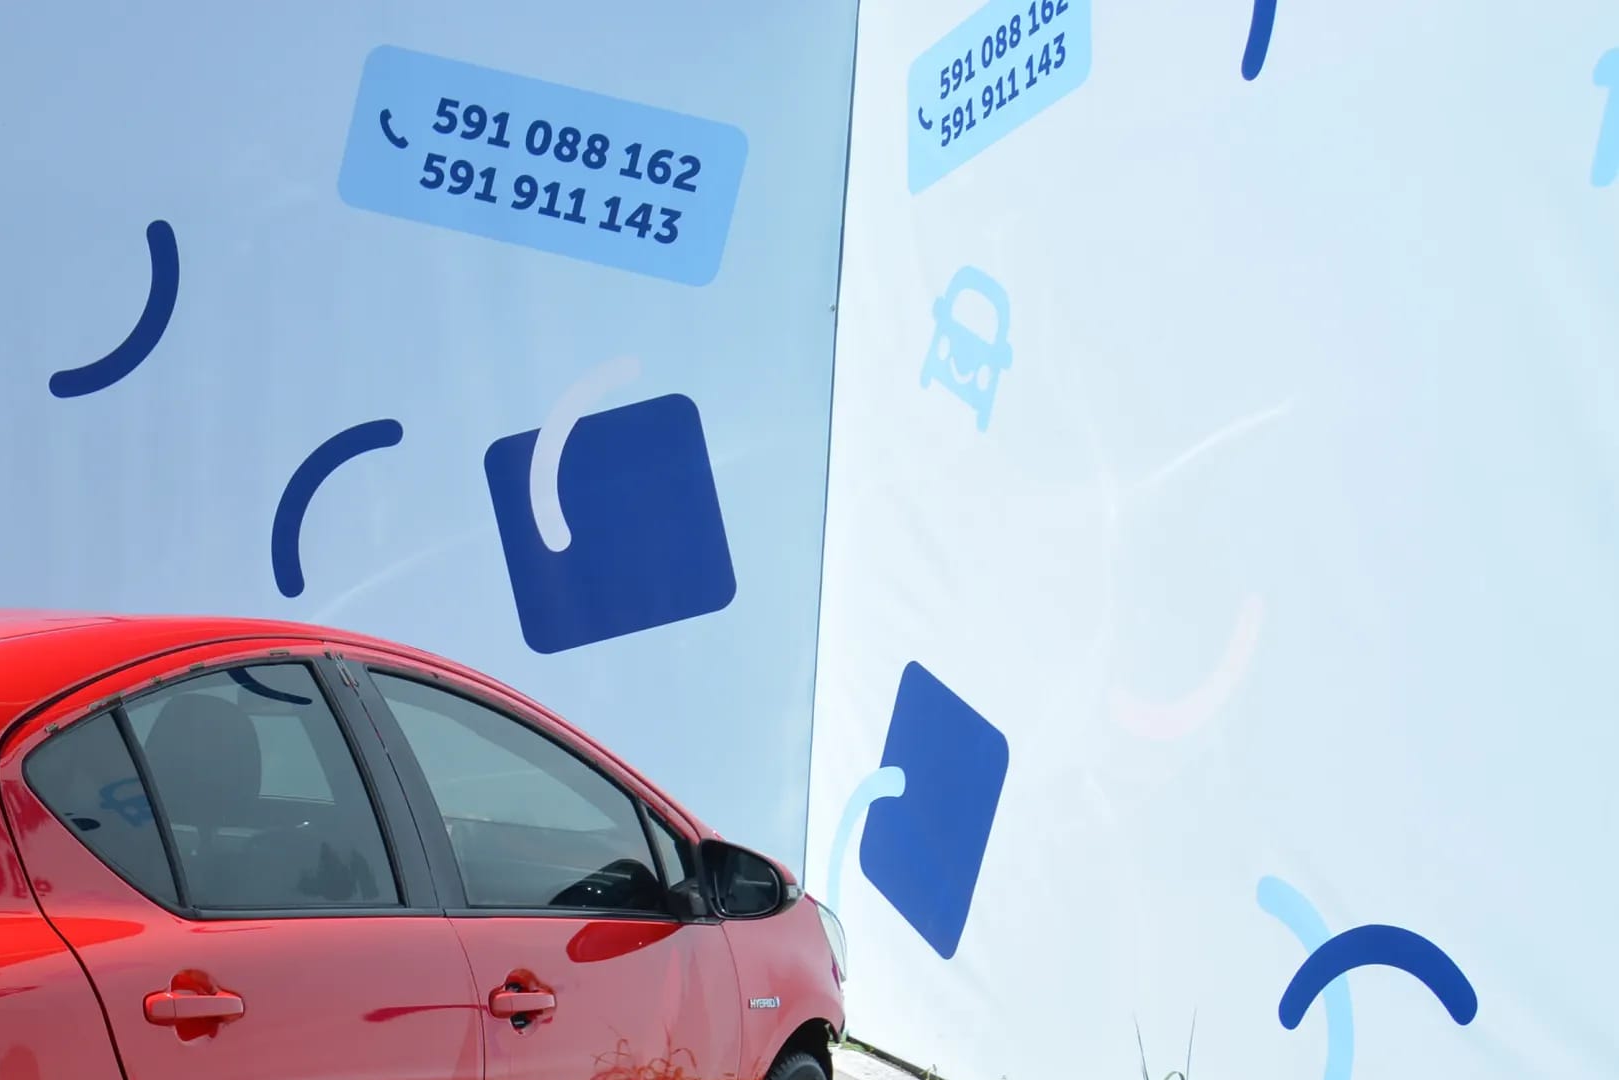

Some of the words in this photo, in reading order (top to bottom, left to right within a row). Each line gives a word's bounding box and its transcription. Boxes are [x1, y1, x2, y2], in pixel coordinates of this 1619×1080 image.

[939, 48, 976, 100] 591
[981, 13, 1022, 69] 088
[940, 97, 977, 148] 591
[981, 66, 1020, 120] 911
[1024, 31, 1066, 90] 143
[431, 97, 511, 149] 591
[525, 119, 611, 170] 088
[618, 142, 702, 193] 162
[419, 152, 499, 204] 591
[510, 174, 588, 225] 911
[598, 195, 683, 245] 143
